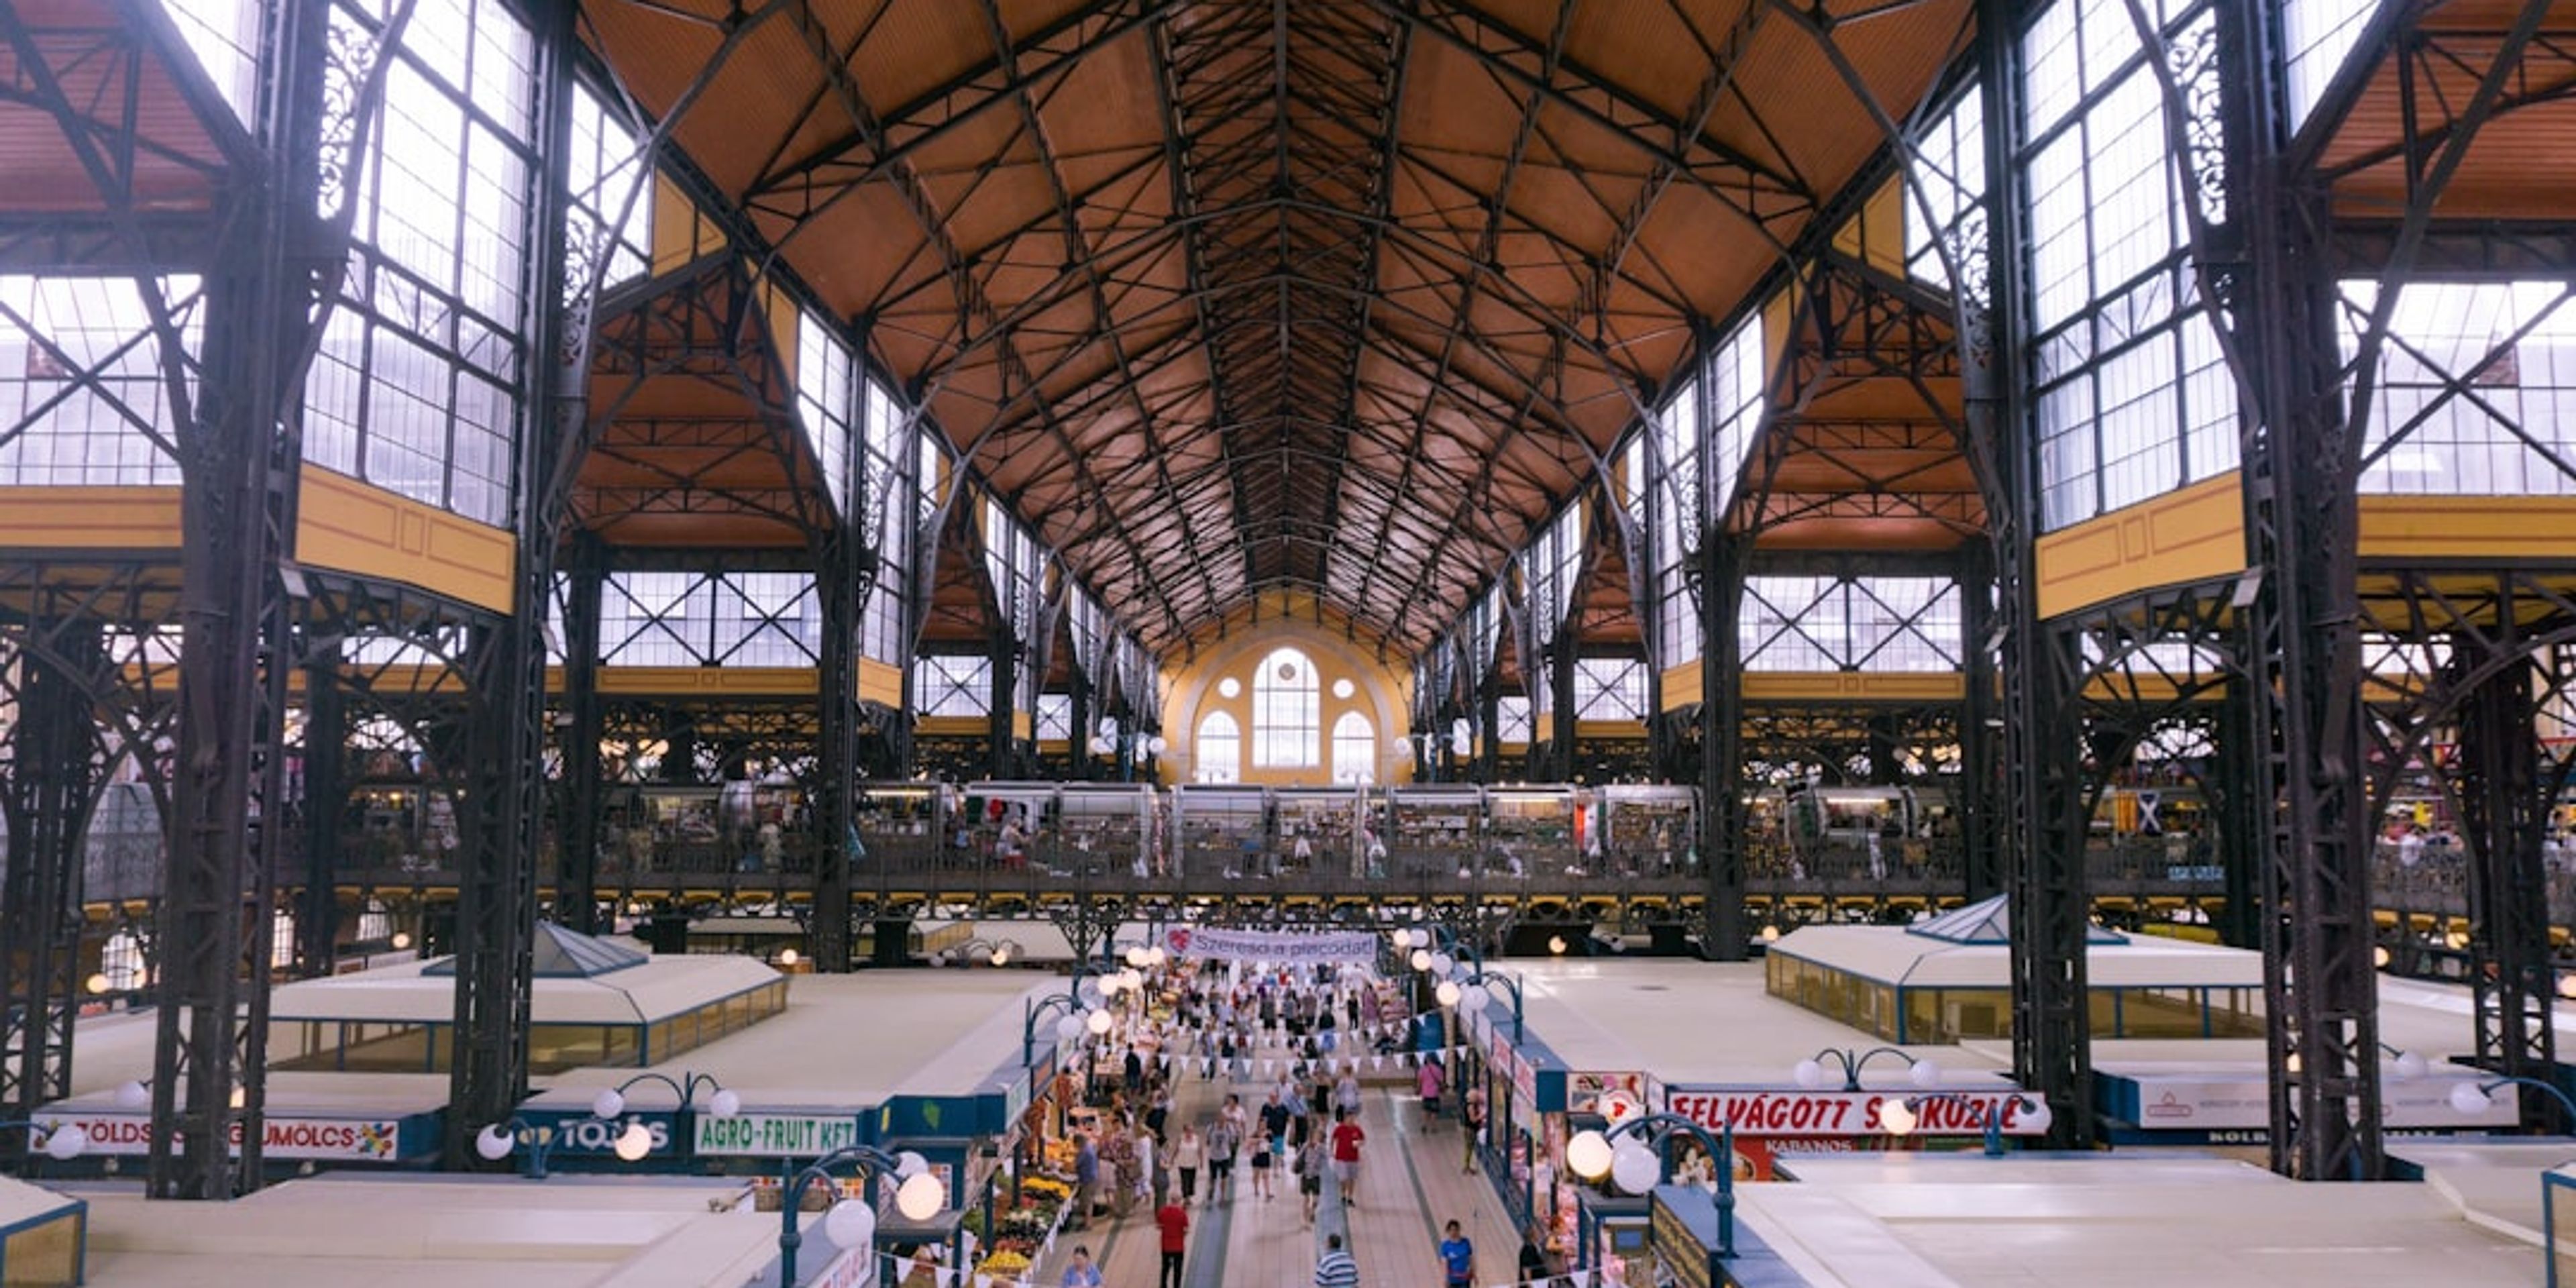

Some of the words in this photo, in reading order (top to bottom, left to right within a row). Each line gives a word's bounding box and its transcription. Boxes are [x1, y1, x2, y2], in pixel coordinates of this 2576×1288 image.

[1275, 945, 1285, 955] a
[1673, 1093, 1852, 1129] FELVÁGOTT
[701, 1118, 815, 1150] AGRO-FRUIT
[820, 1122, 853, 1150] KFT
